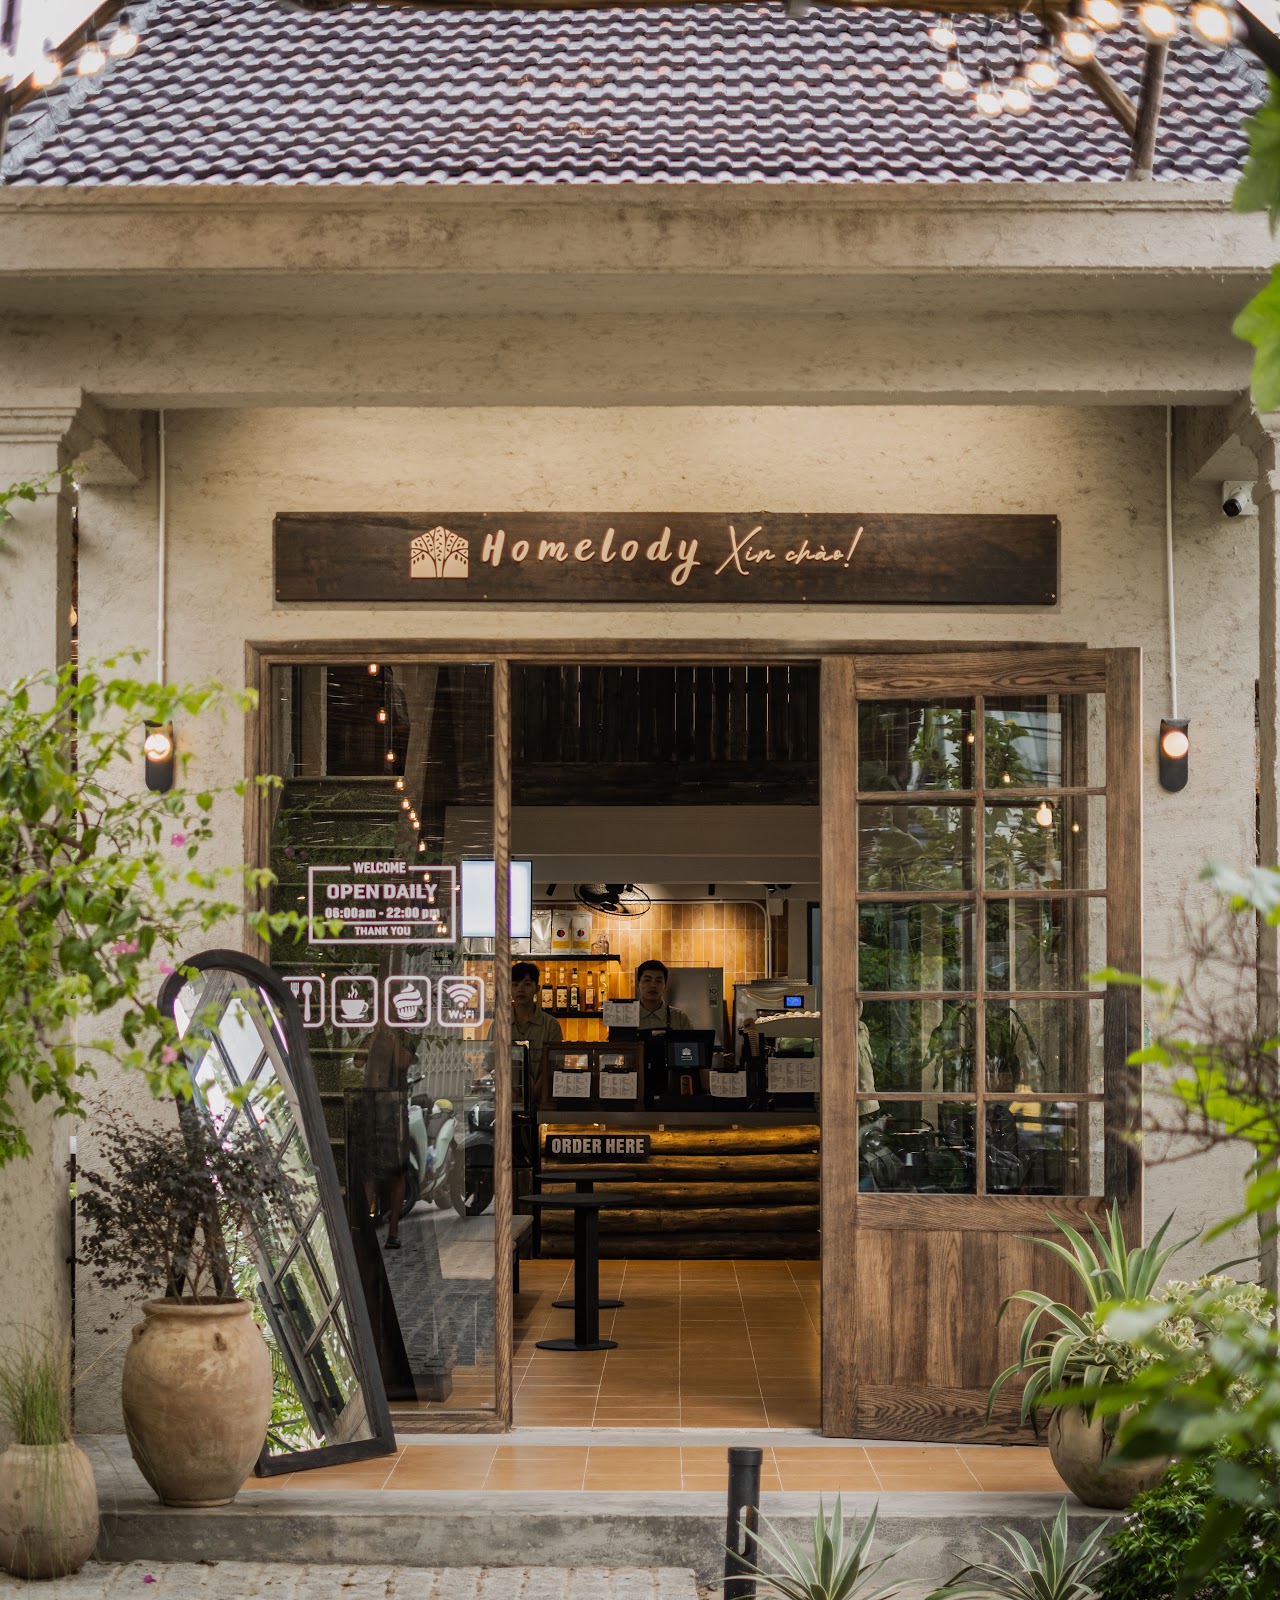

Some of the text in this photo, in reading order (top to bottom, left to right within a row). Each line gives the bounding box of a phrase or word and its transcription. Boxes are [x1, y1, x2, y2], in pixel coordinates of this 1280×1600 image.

[482, 525, 864, 586] Homelody Xin chào!
[353, 862, 407, 874] WELCOME
[326, 883, 438, 900] OPEN DAILY
[324, 907, 377, 919] 06:00am
[386, 907, 420, 919] 22:00
[421, 908, 440, 920] pm
[354, 926, 411, 936] THANK YOU
[448, 1009, 475, 1019] Wi-Fi
[551, 1138, 645, 1154] ORDER HERE
